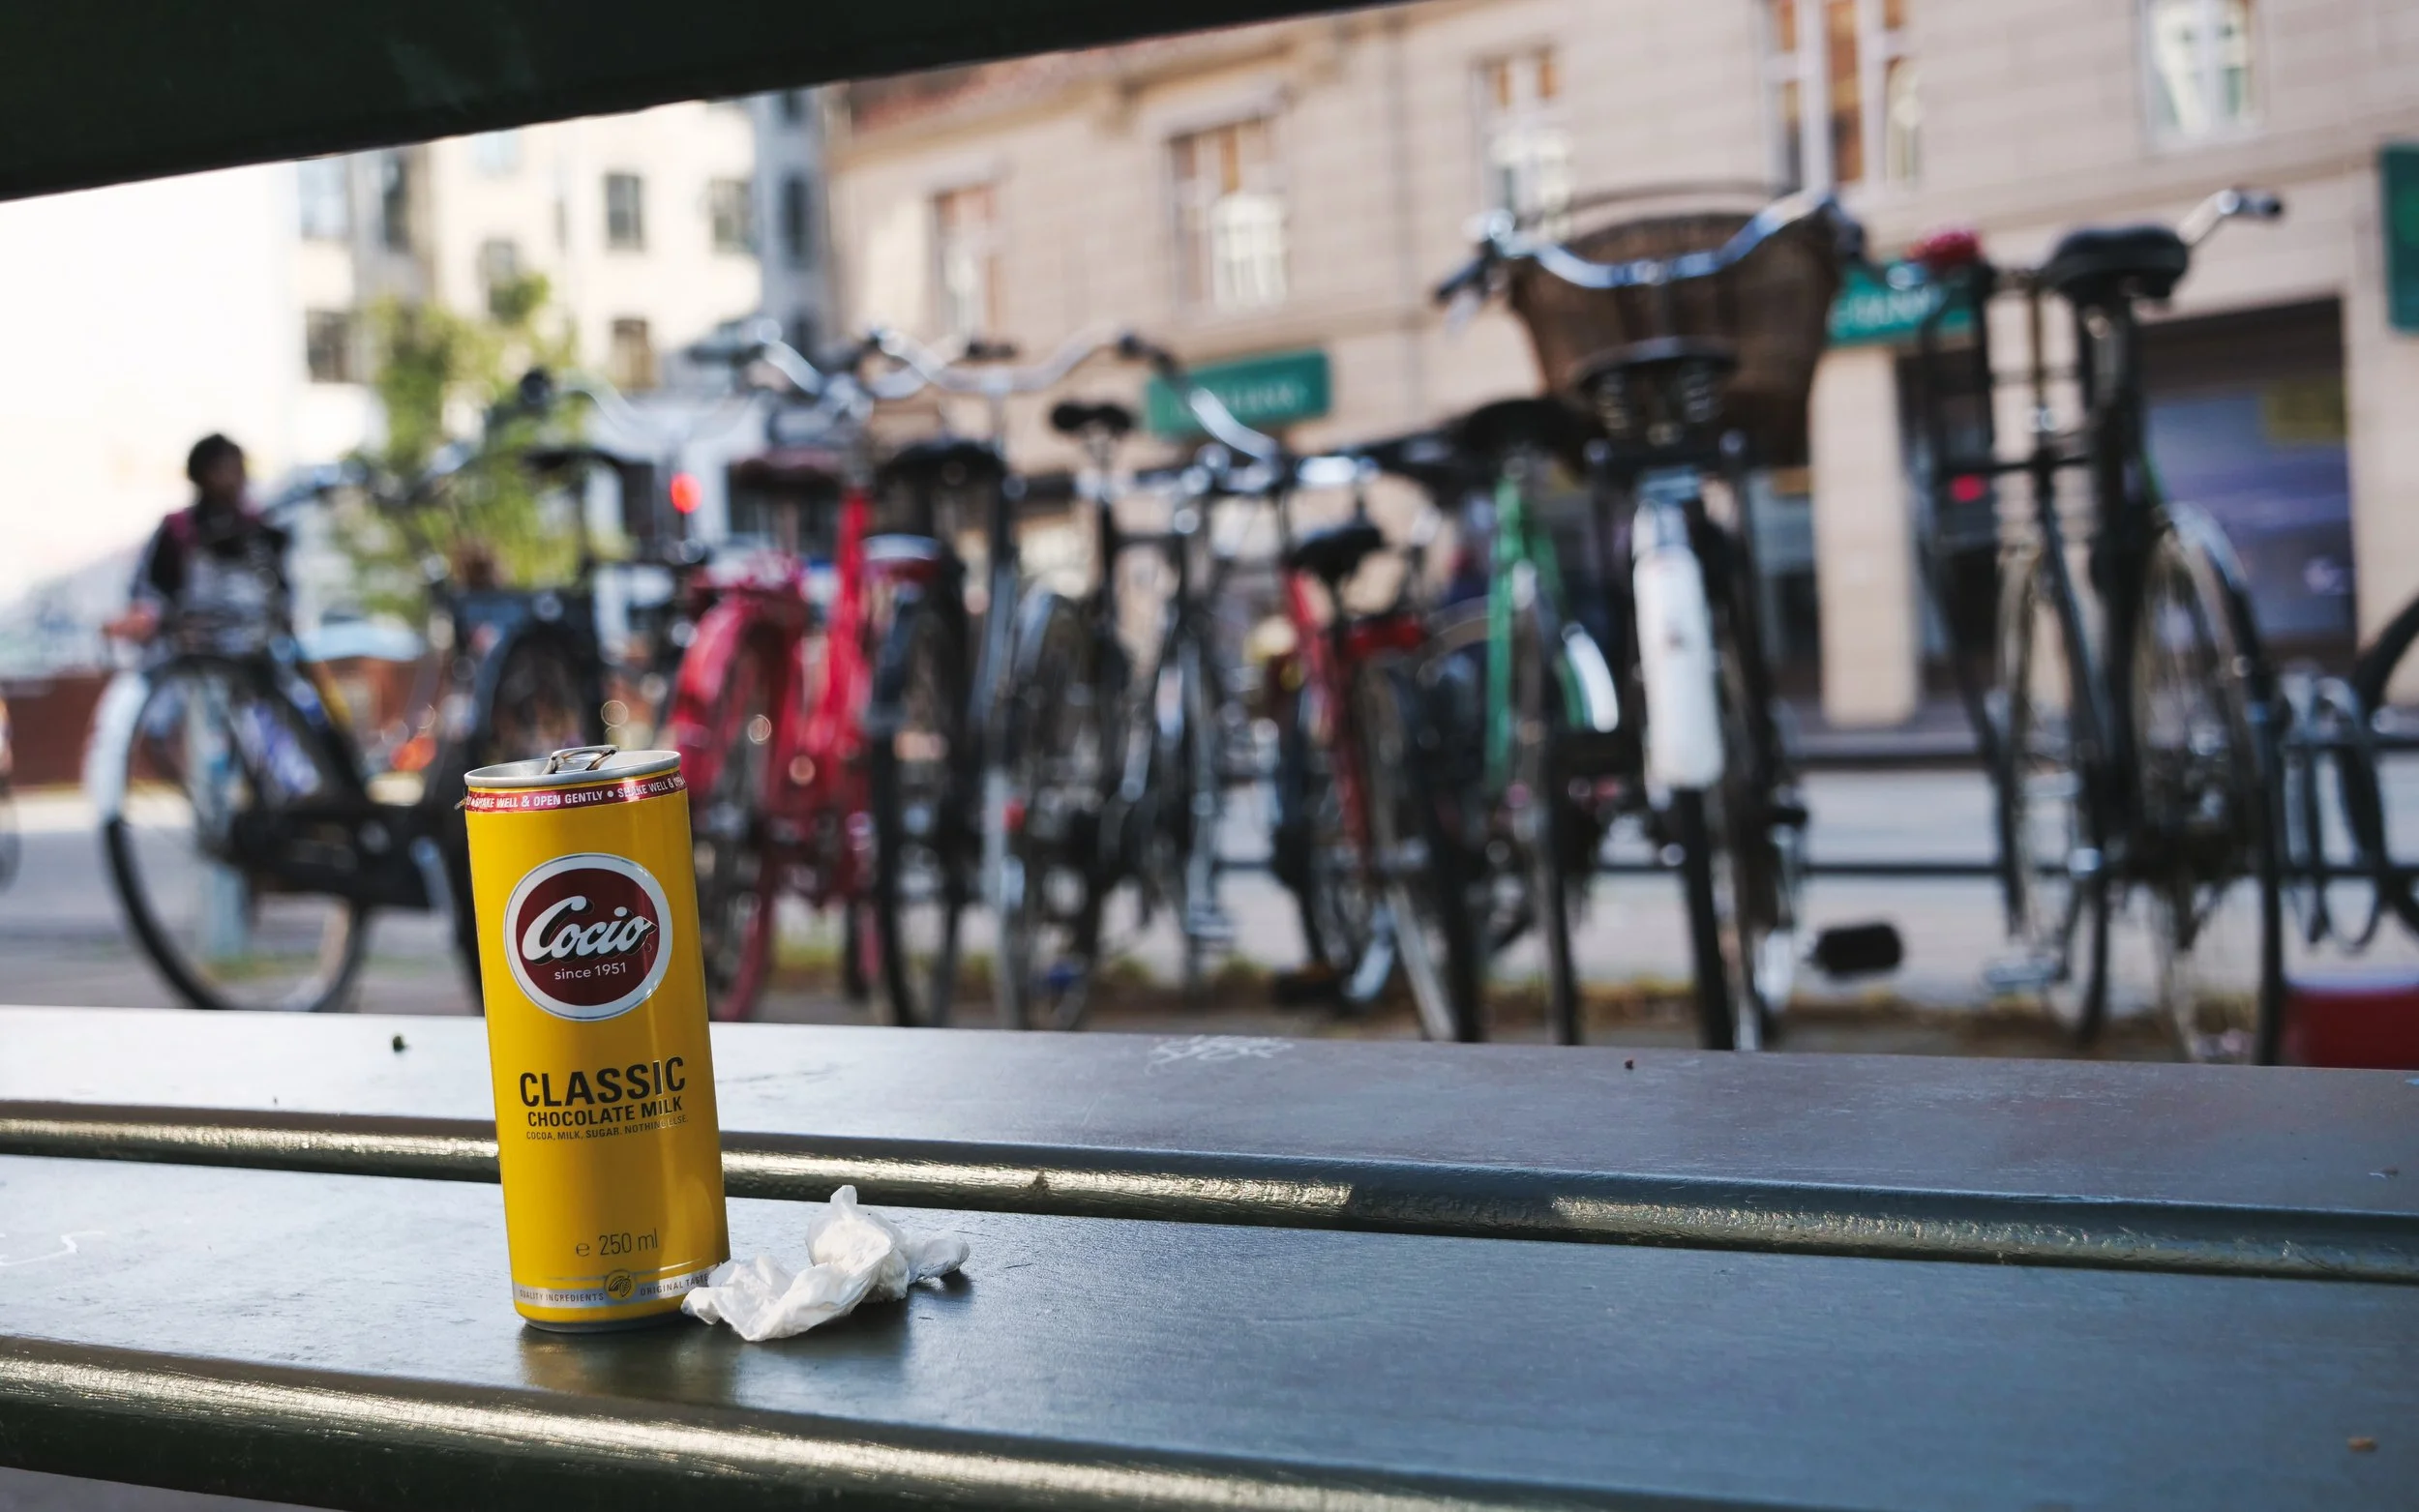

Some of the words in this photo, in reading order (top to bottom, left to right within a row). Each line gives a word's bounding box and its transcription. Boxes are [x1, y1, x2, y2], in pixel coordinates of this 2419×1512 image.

[496, 796, 518, 808] WELL
[522, 795, 530, 807] &
[533, 793, 561, 807] OPEN
[564, 789, 603, 805] GENTLY
[617, 785, 648, 798] SHAKE
[648, 780, 667, 792] WELL
[668, 778, 674, 788] &
[523, 895, 653, 962] Cocio
[554, 968, 591, 980] since
[594, 962, 626, 976] 1951
[520, 1056, 686, 1108] CLASSIC
[527, 1104, 636, 1127] CHOCOLATE
[641, 1095, 683, 1119] MILK
[526, 1131, 555, 1141] COCOA,
[557, 1130, 583, 1141] MILK,
[585, 1126, 622, 1139] SUGAR.
[624, 1120, 666, 1135] NOTHING
[598, 1232, 632, 1256] 250
[638, 1229, 658, 1250] ml
[546, 1292, 604, 1302] INGREDIENTS
[641, 1281, 683, 1296] ORIGINAL
[685, 1273, 708, 1287] TASTE
